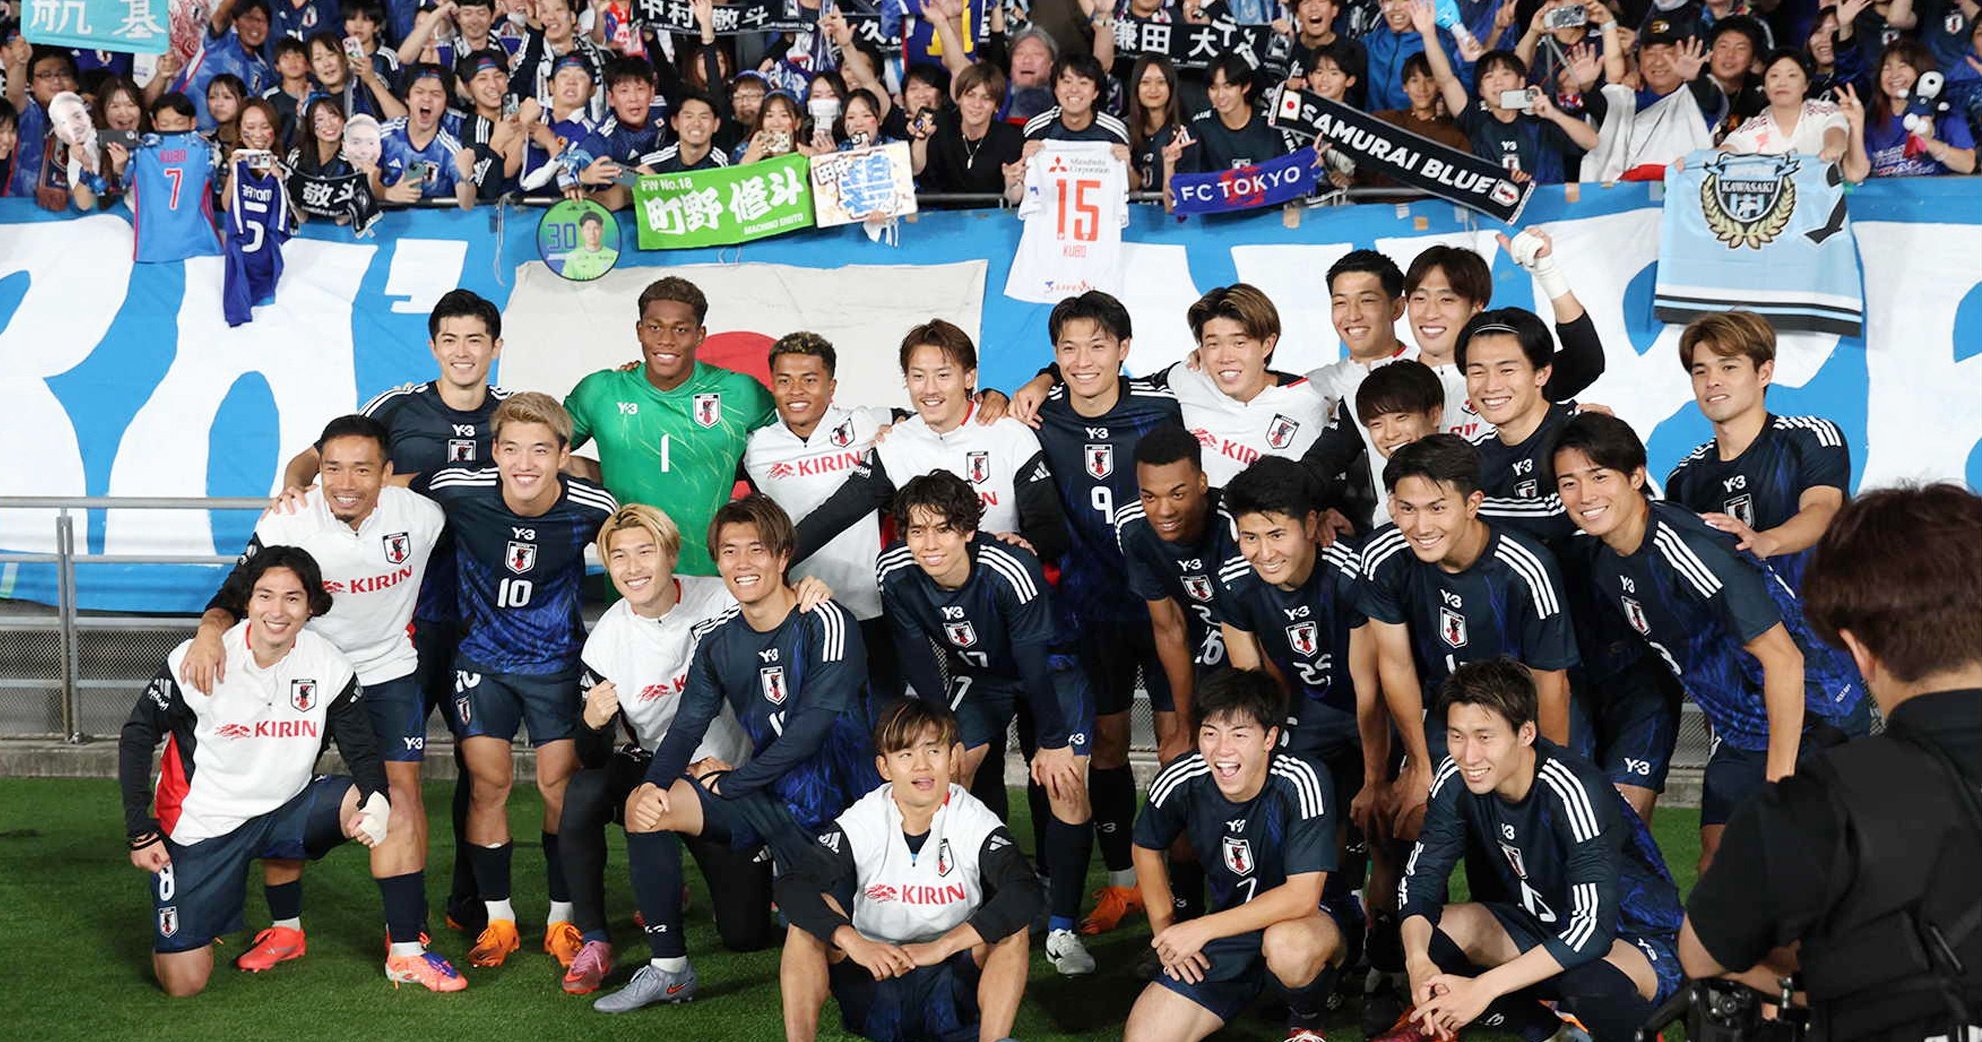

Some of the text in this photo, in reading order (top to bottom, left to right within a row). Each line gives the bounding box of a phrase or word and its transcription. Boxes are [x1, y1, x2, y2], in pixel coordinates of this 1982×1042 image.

[1301, 103, 1420, 171] SAMURAI
[1420, 157, 1497, 196] BLUE
[164, 168, 183, 210] 7
[660, 176, 693, 191] No.18
[1180, 184, 1213, 202] FC
[1217, 166, 1301, 199] TOKYO
[1721, 181, 1774, 193] KAWASAKI
[644, 166, 803, 235] 町野 修斗
[1056, 179, 1101, 242] 15
[548, 223, 577, 250] 30
[1062, 245, 1087, 258] KUBO
[617, 402, 639, 415] Y-3
[452, 424, 476, 437] Y-3
[1085, 427, 1109, 440] Y-3
[660, 433, 670, 473] 1
[798, 450, 861, 477] KIRIN
[1513, 458, 1533, 476] Y-3
[1722, 474, 1747, 493] Y-3
[1090, 486, 1115, 524] 9
[512, 527, 537, 541] Y-3
[1177, 559, 1203, 573] Y-3
[349, 564, 413, 594] KIRIN
[1619, 575, 1636, 593] Y-3
[497, 577, 533, 609] 10
[1440, 588, 1463, 609] Y-3
[940, 606, 965, 620] Y-3
[1284, 605, 1311, 621] Y-3
[758, 647, 779, 663] Y-3
[255, 719, 317, 739] KIRIN
[768, 710, 786, 738] 1
[404, 736, 424, 750] Y-3
[1624, 757, 1651, 776] Y-3
[1225, 818, 1247, 833] Y-3
[158, 862, 176, 902] 8
[1236, 877, 1257, 904] 7
[902, 882, 968, 906] KIRIN
